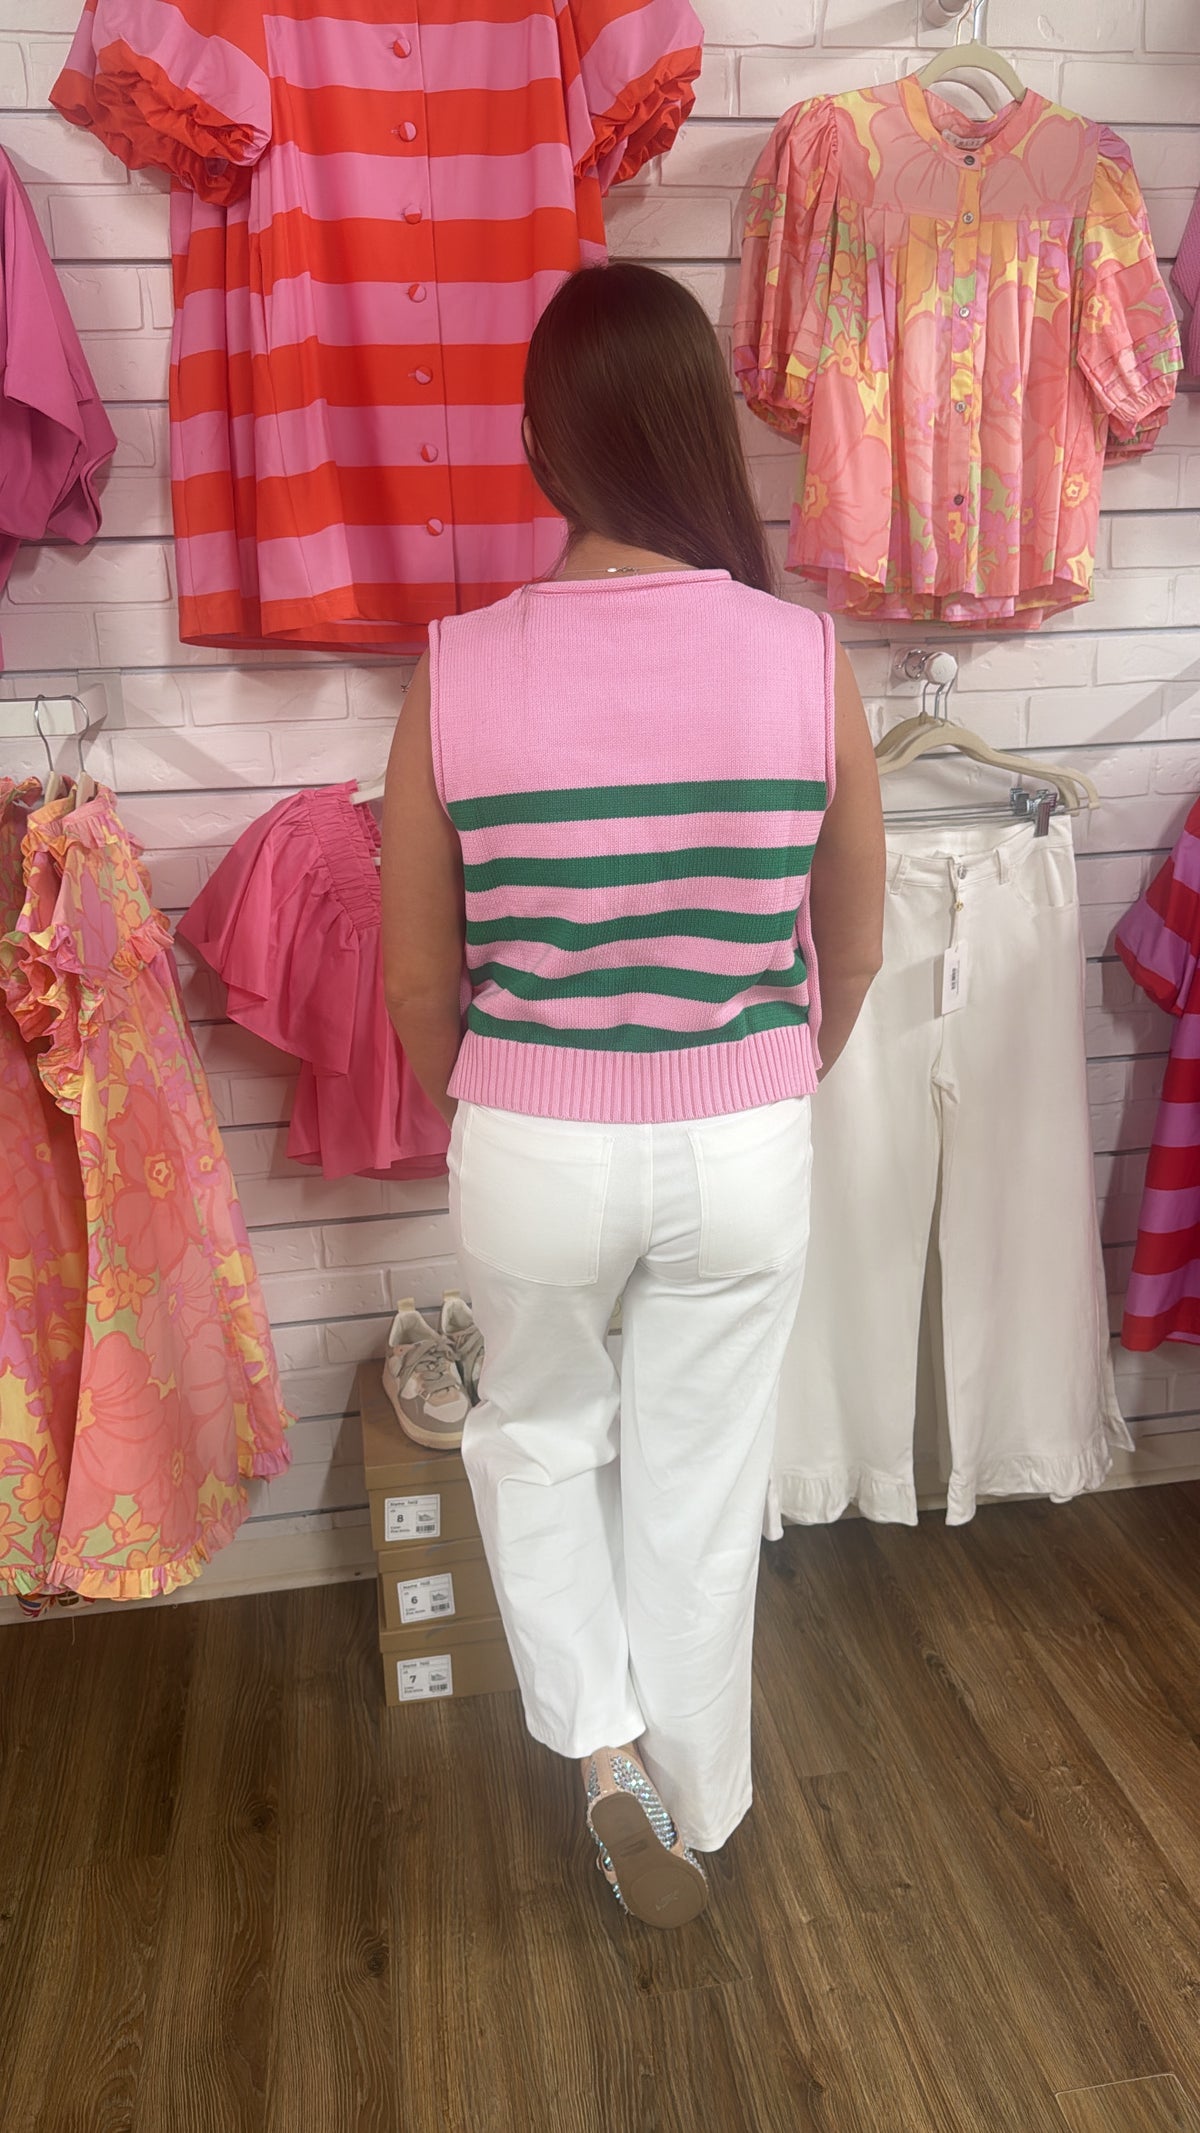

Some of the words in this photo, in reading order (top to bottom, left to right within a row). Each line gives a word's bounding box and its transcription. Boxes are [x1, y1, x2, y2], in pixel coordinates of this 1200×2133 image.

[397, 1514, 404, 1523] 8
[411, 1596, 418, 1604] 6
[409, 1675, 416, 1683] 7
